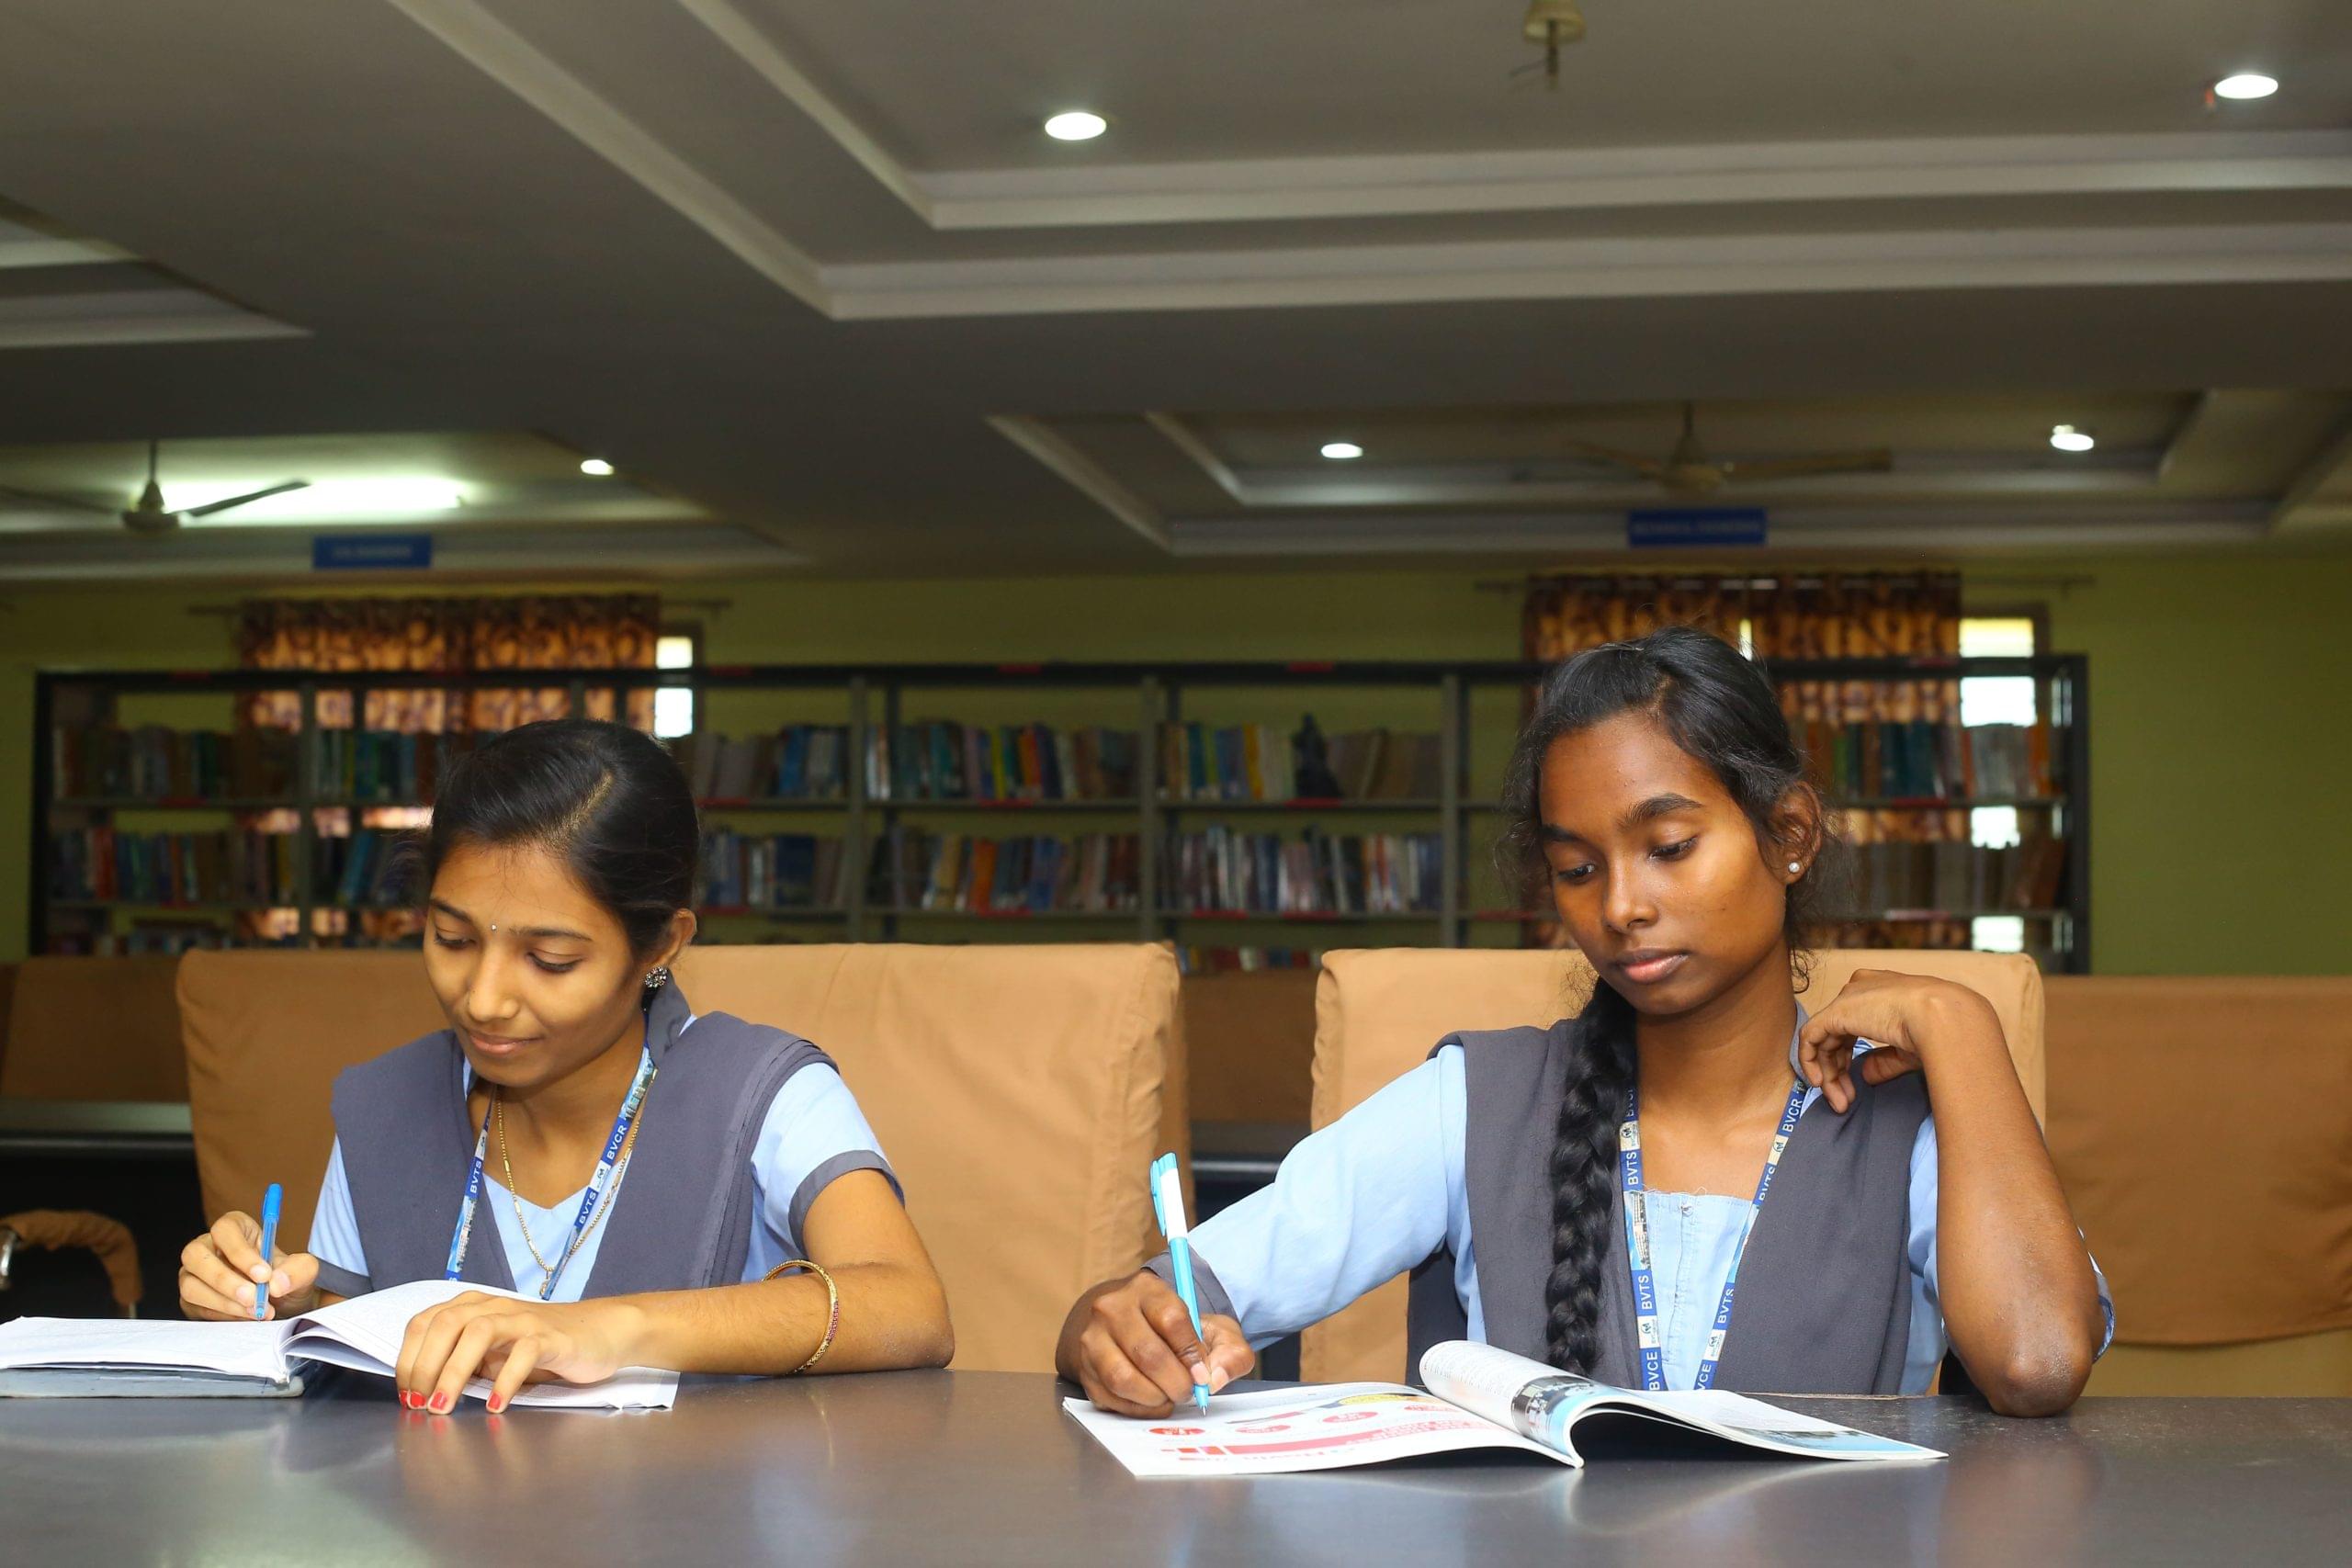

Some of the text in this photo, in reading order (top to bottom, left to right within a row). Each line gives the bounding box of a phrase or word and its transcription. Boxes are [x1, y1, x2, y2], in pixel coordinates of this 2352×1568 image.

[1781, 1098, 1803, 1133] BVCR
[606, 1124, 627, 1160] BVCR
[469, 1159, 482, 1194] BVTS
[1626, 1151, 1639, 1186] BVTS
[579, 1191, 597, 1224] BVTS
[1638, 1274, 1653, 1310] BVTS
[1717, 1288, 1735, 1324] BVTS
[1646, 1351, 1660, 1391] BVCE
[1696, 1363, 1712, 1391] VCE
